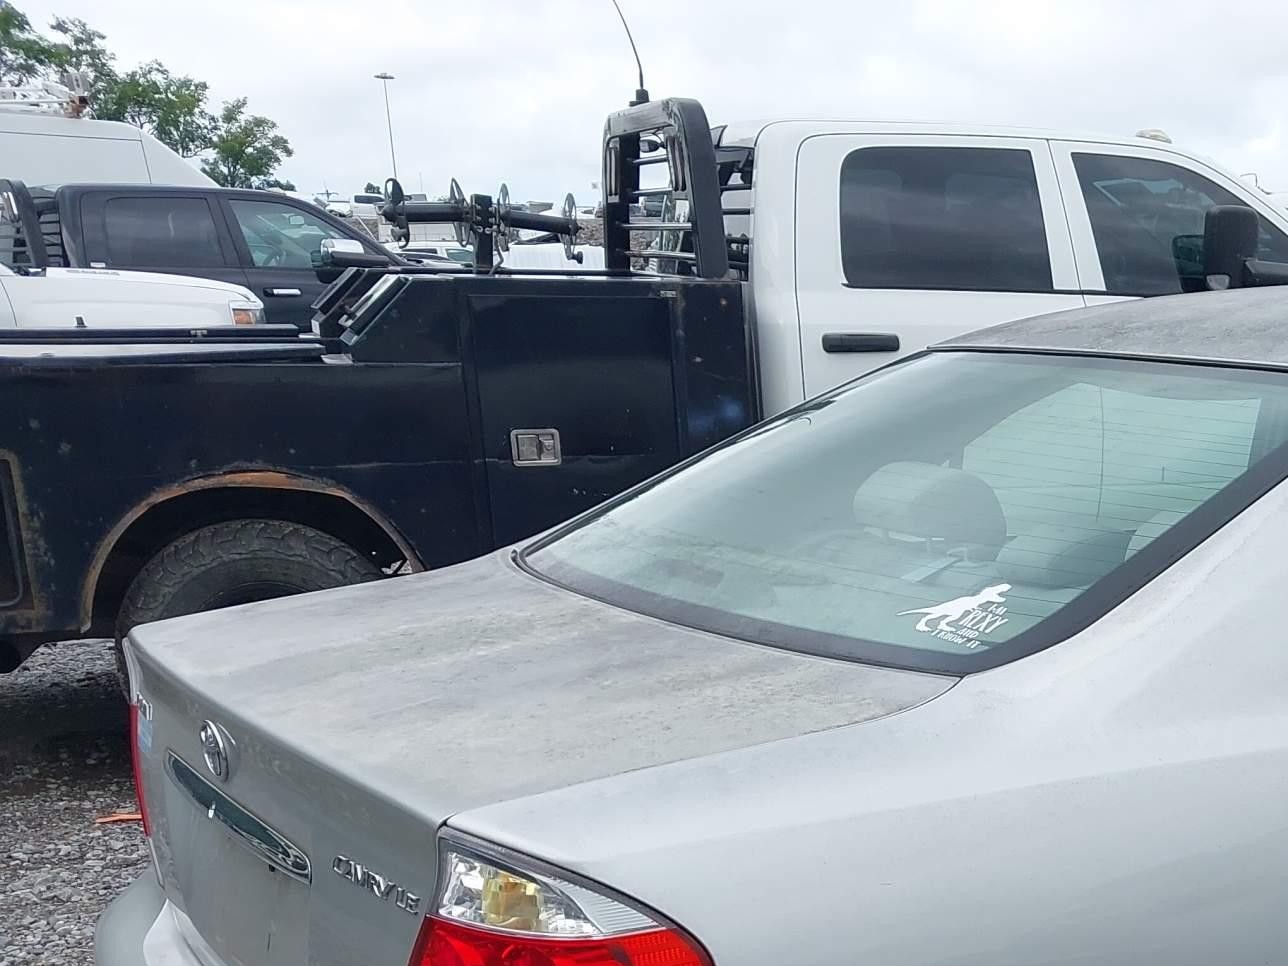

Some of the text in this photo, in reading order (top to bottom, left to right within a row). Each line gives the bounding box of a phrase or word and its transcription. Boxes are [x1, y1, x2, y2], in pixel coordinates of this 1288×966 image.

[957, 608, 1009, 634] REXY
[937, 630, 968, 644] KNOW
[966, 640, 982, 649] IT
[956, 628, 979, 639] AND
[333, 855, 420, 915] CAMRY LE
